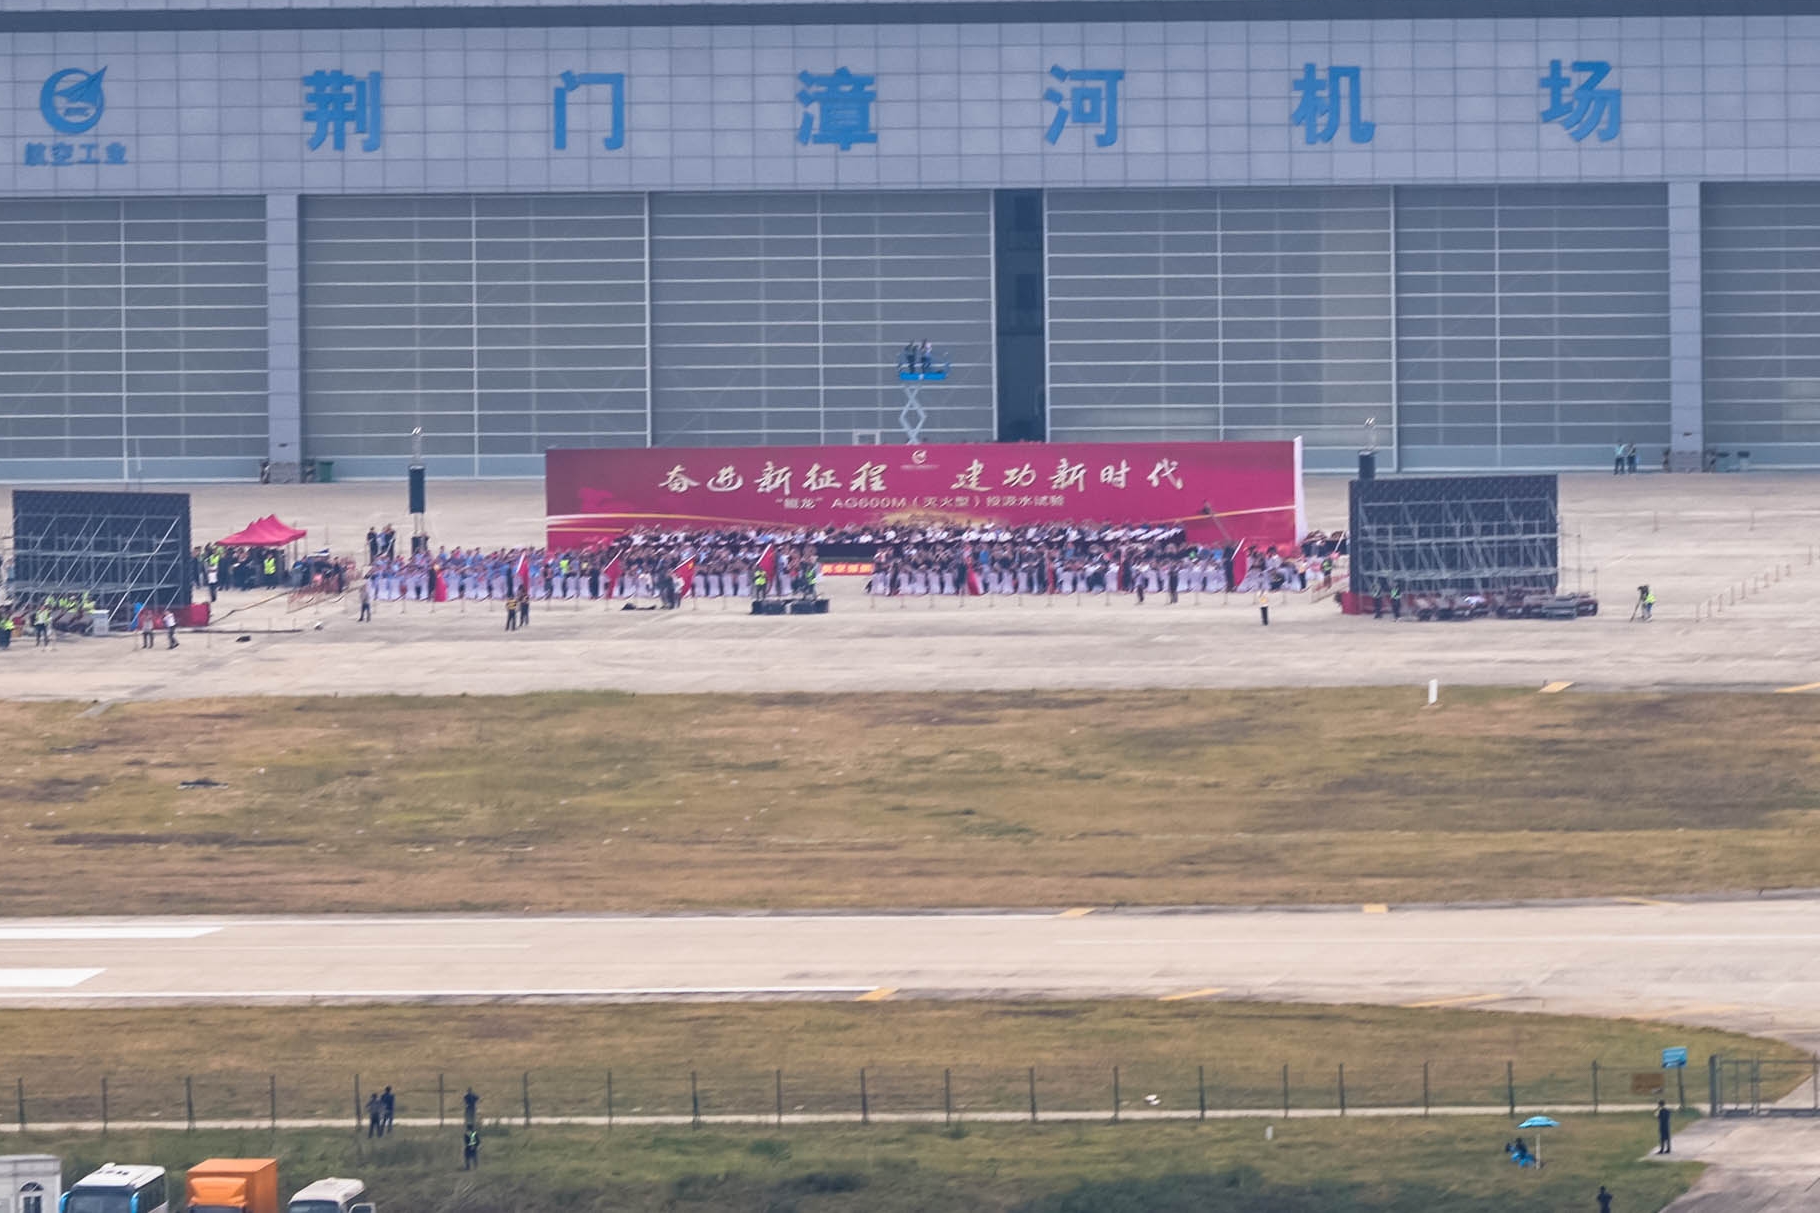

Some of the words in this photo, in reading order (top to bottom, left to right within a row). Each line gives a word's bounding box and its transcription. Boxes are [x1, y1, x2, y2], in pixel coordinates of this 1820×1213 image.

[302, 59, 1622, 153] 荆门漳河机场
[24, 143, 128, 167] 航空工业
[658, 460, 888, 496] 奋进新征程
[950, 457, 1184, 492] 建功新时代
